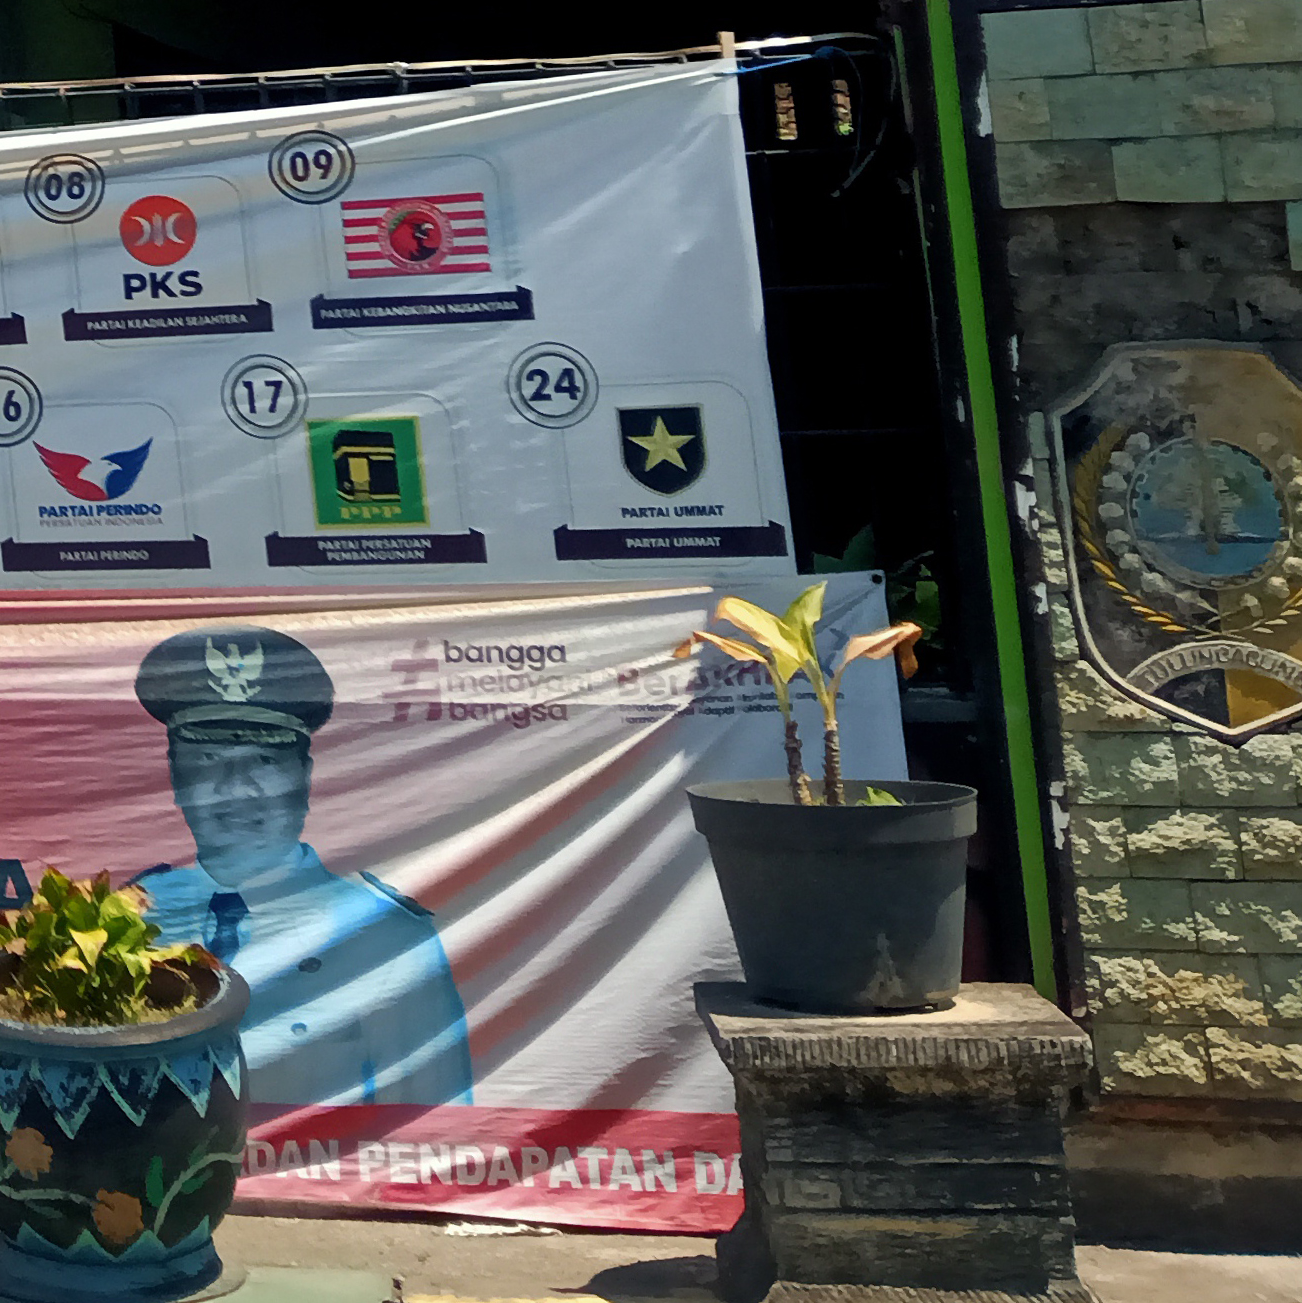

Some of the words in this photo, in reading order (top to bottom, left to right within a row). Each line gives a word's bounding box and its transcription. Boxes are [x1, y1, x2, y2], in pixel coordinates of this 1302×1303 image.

[289, 149, 333, 182] 09
[44, 173, 84, 201] 08
[123, 270, 202, 300] PKS
[243, 380, 283, 414] 17
[526, 367, 581, 402] 24
[38, 505, 93, 518] PARTAI
[96, 503, 162, 517] PERINDO
[621, 507, 670, 518] PARTAI
[674, 505, 724, 517] UMMAT
[626, 538, 670, 548] PARTAI
[673, 537, 720, 547] UMMAT
[444, 640, 566, 671] bangga
[240, 1140, 340, 1181] DAN
[359, 1142, 676, 1193] PENDAPATAN
